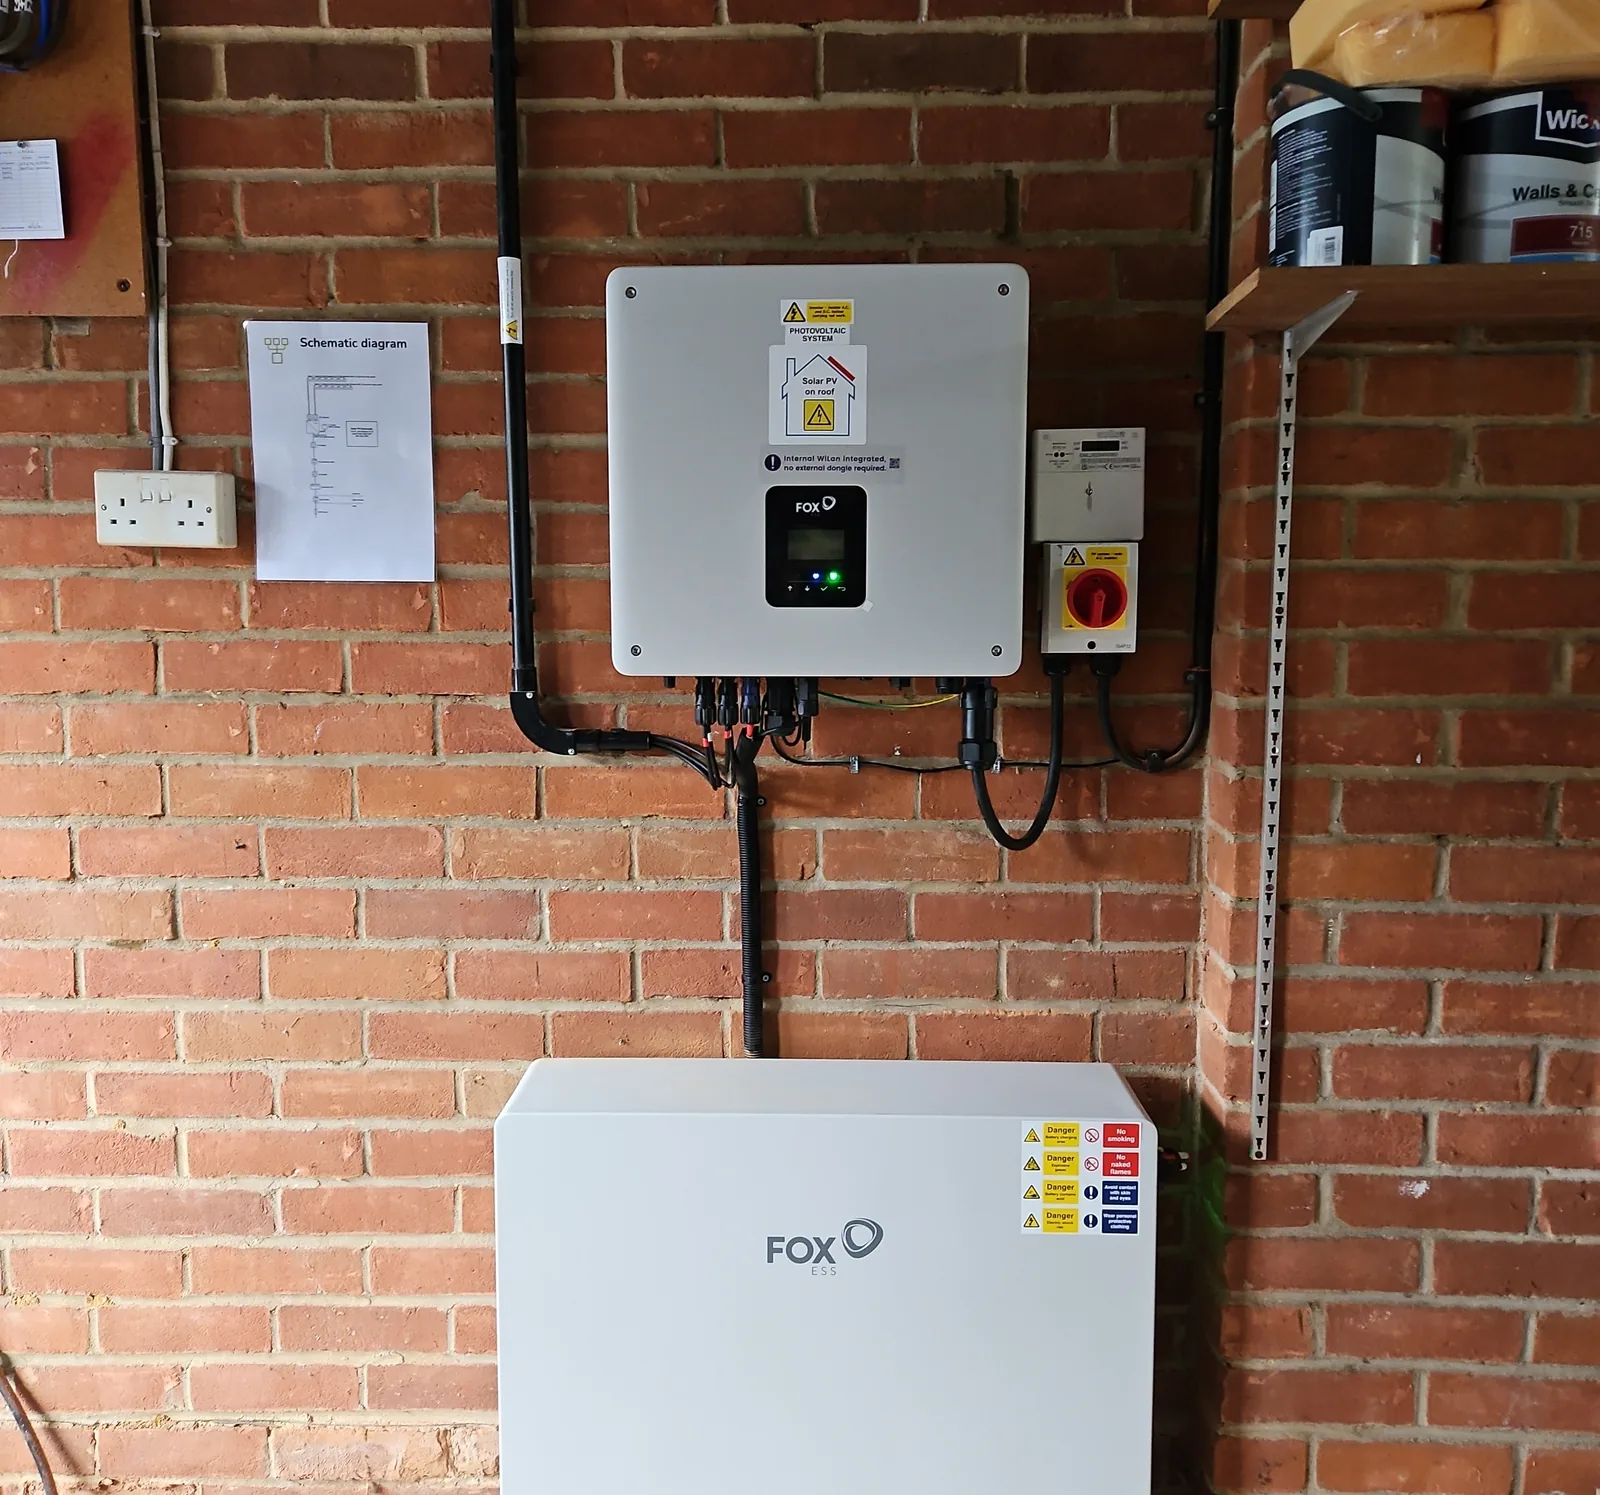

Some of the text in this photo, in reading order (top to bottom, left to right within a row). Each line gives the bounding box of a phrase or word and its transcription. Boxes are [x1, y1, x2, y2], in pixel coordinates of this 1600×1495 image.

[1512, 184, 1560, 201] Walls
[1566, 184, 1577, 198] &
[1570, 226, 1593, 238] 715
[300, 337, 407, 350] Schematic diagram
[802, 377, 838, 385] Solar PV
[827, 465, 852, 473] dongle
[854, 465, 886, 473] required.
[796, 502, 820, 513] FOX
[1047, 1155, 1075, 1163] Danger
[1047, 1183, 1074, 1192] Danger
[1046, 1212, 1074, 1220] Danger
[767, 1236, 836, 1264] FOX
[812, 1267, 837, 1276] ESS
